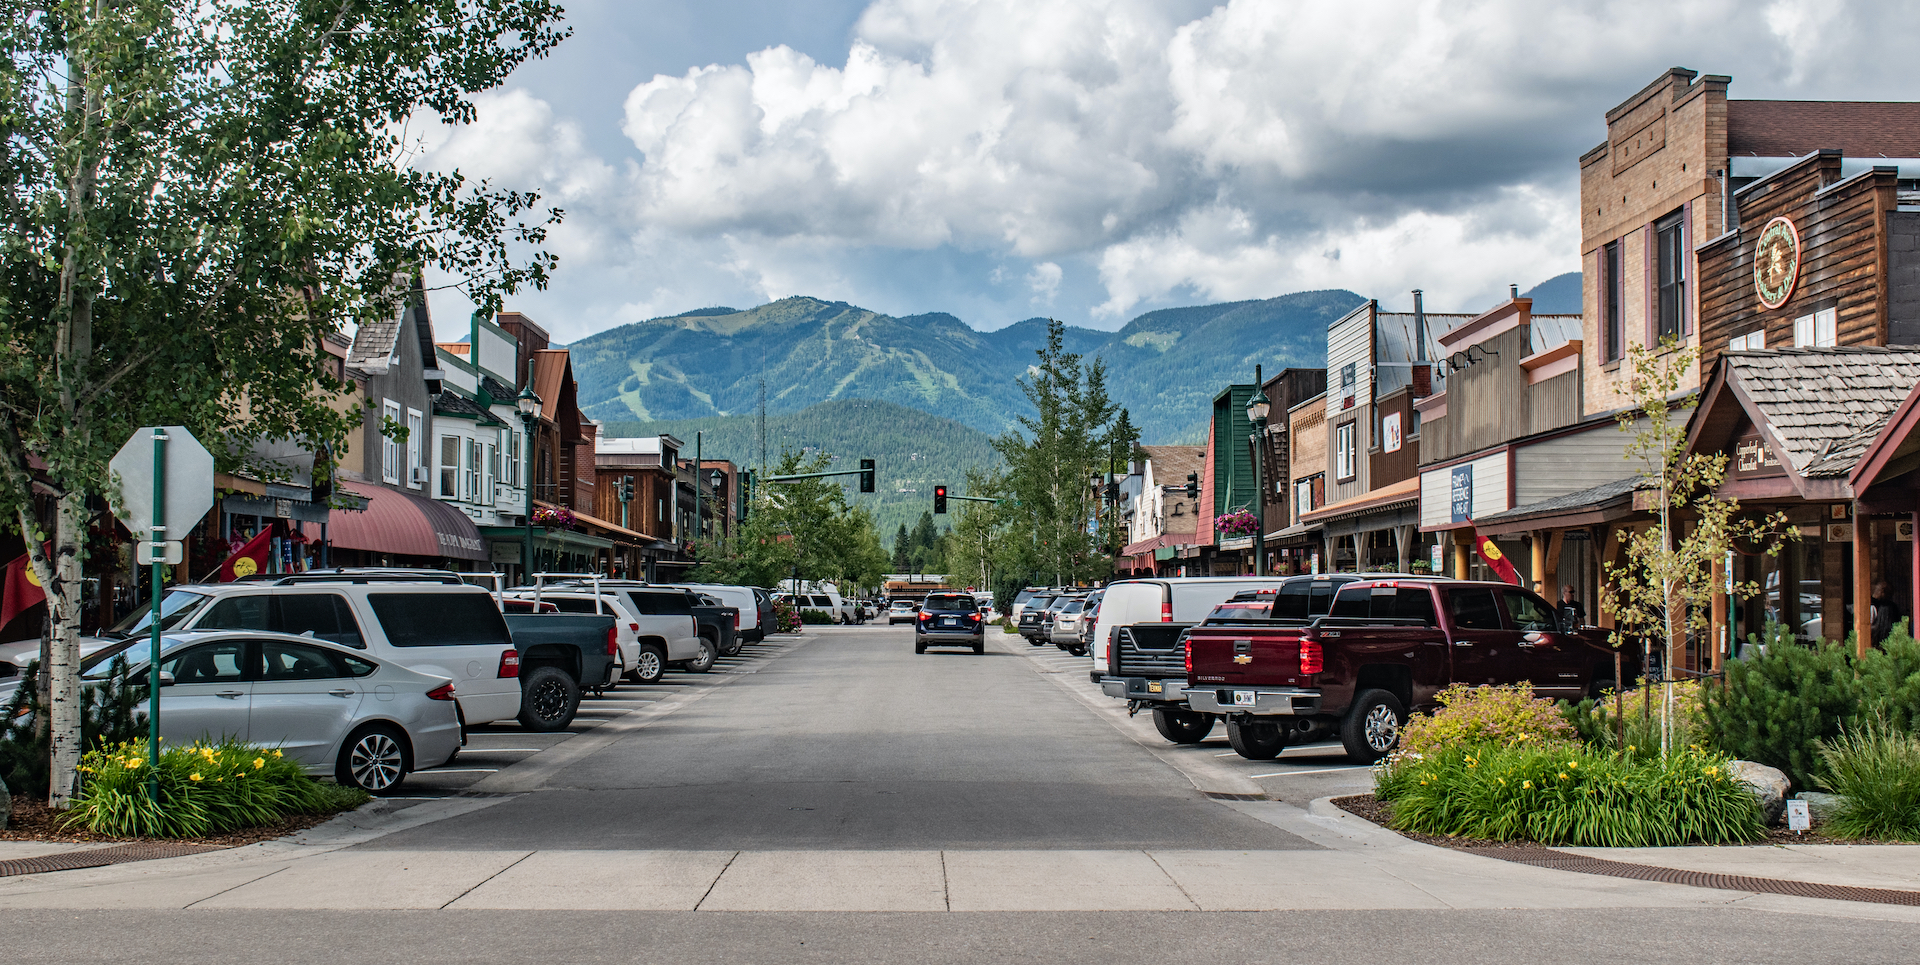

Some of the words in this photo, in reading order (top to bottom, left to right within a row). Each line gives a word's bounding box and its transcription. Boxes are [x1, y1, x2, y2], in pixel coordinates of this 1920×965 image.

[1758, 223, 1781, 257] Central
[1781, 225, 1794, 252] Ave.
[1757, 267, 1777, 304] Bakery
[1778, 286, 1784, 299] &
[1783, 259, 1796, 292] Deli
